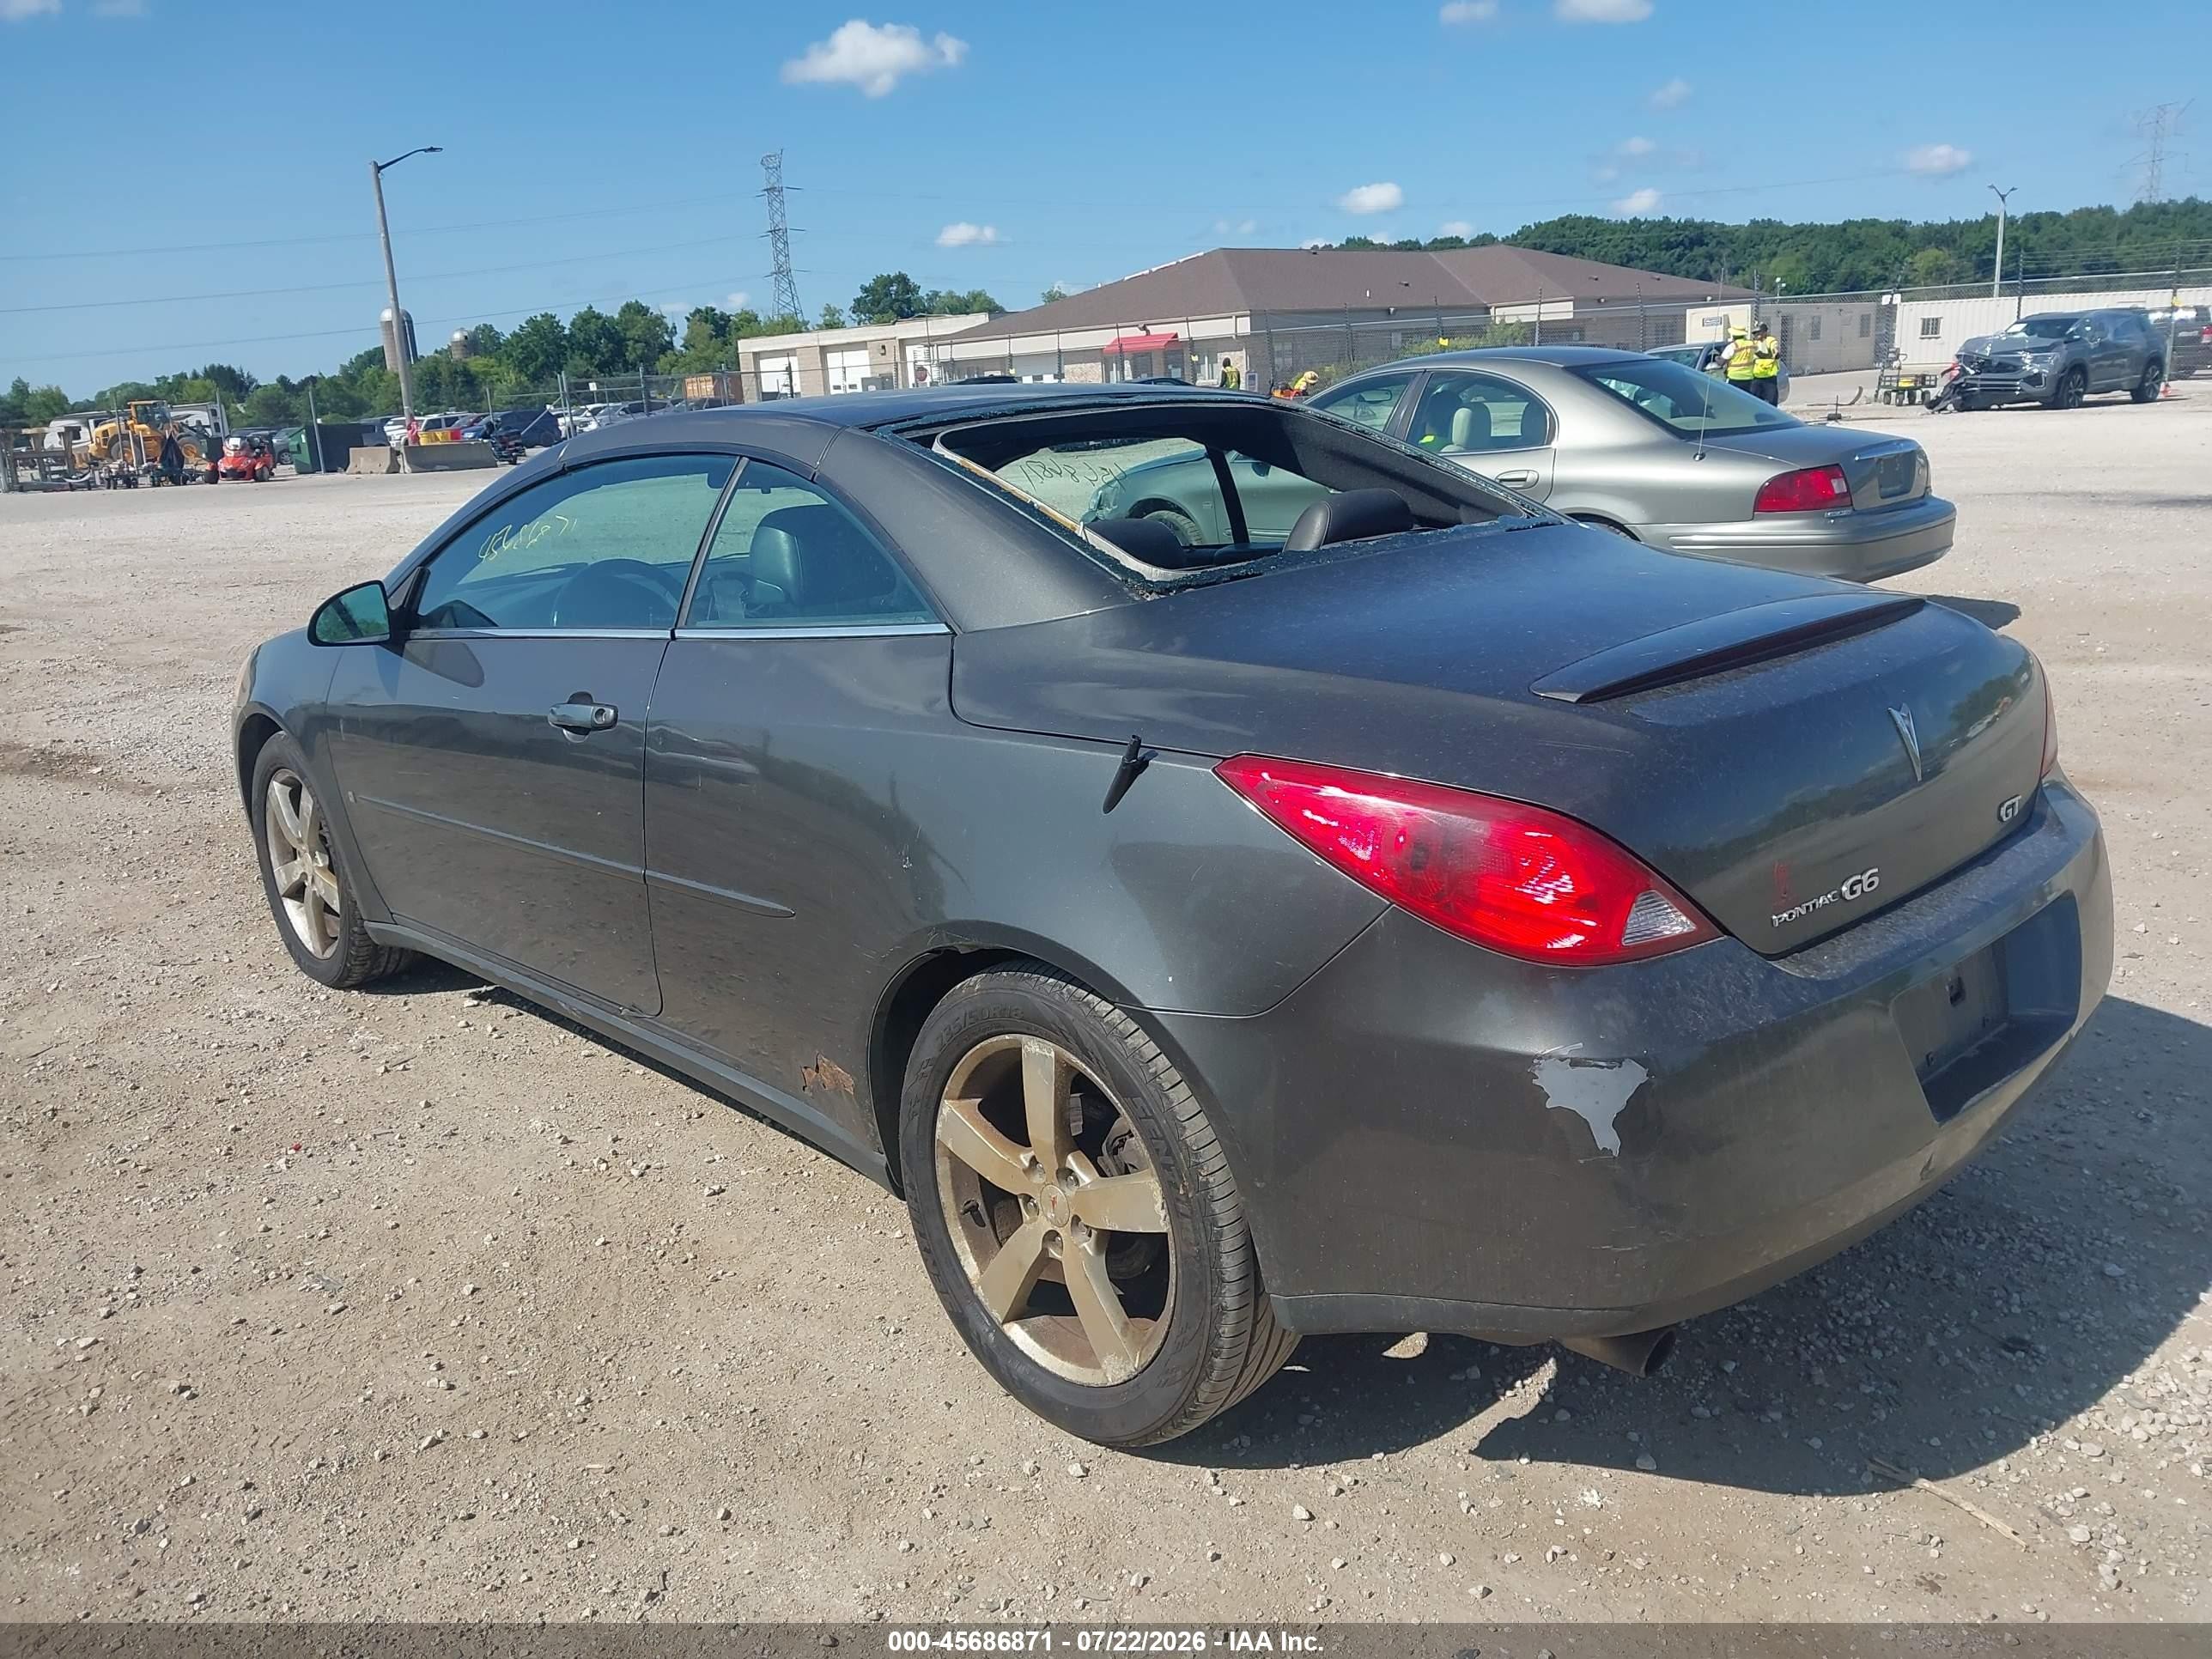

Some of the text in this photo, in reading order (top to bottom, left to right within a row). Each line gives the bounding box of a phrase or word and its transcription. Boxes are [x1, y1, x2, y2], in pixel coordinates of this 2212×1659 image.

[1998, 794, 2022, 822] GT
[1771, 867, 1881, 927] PONTIAC G6
